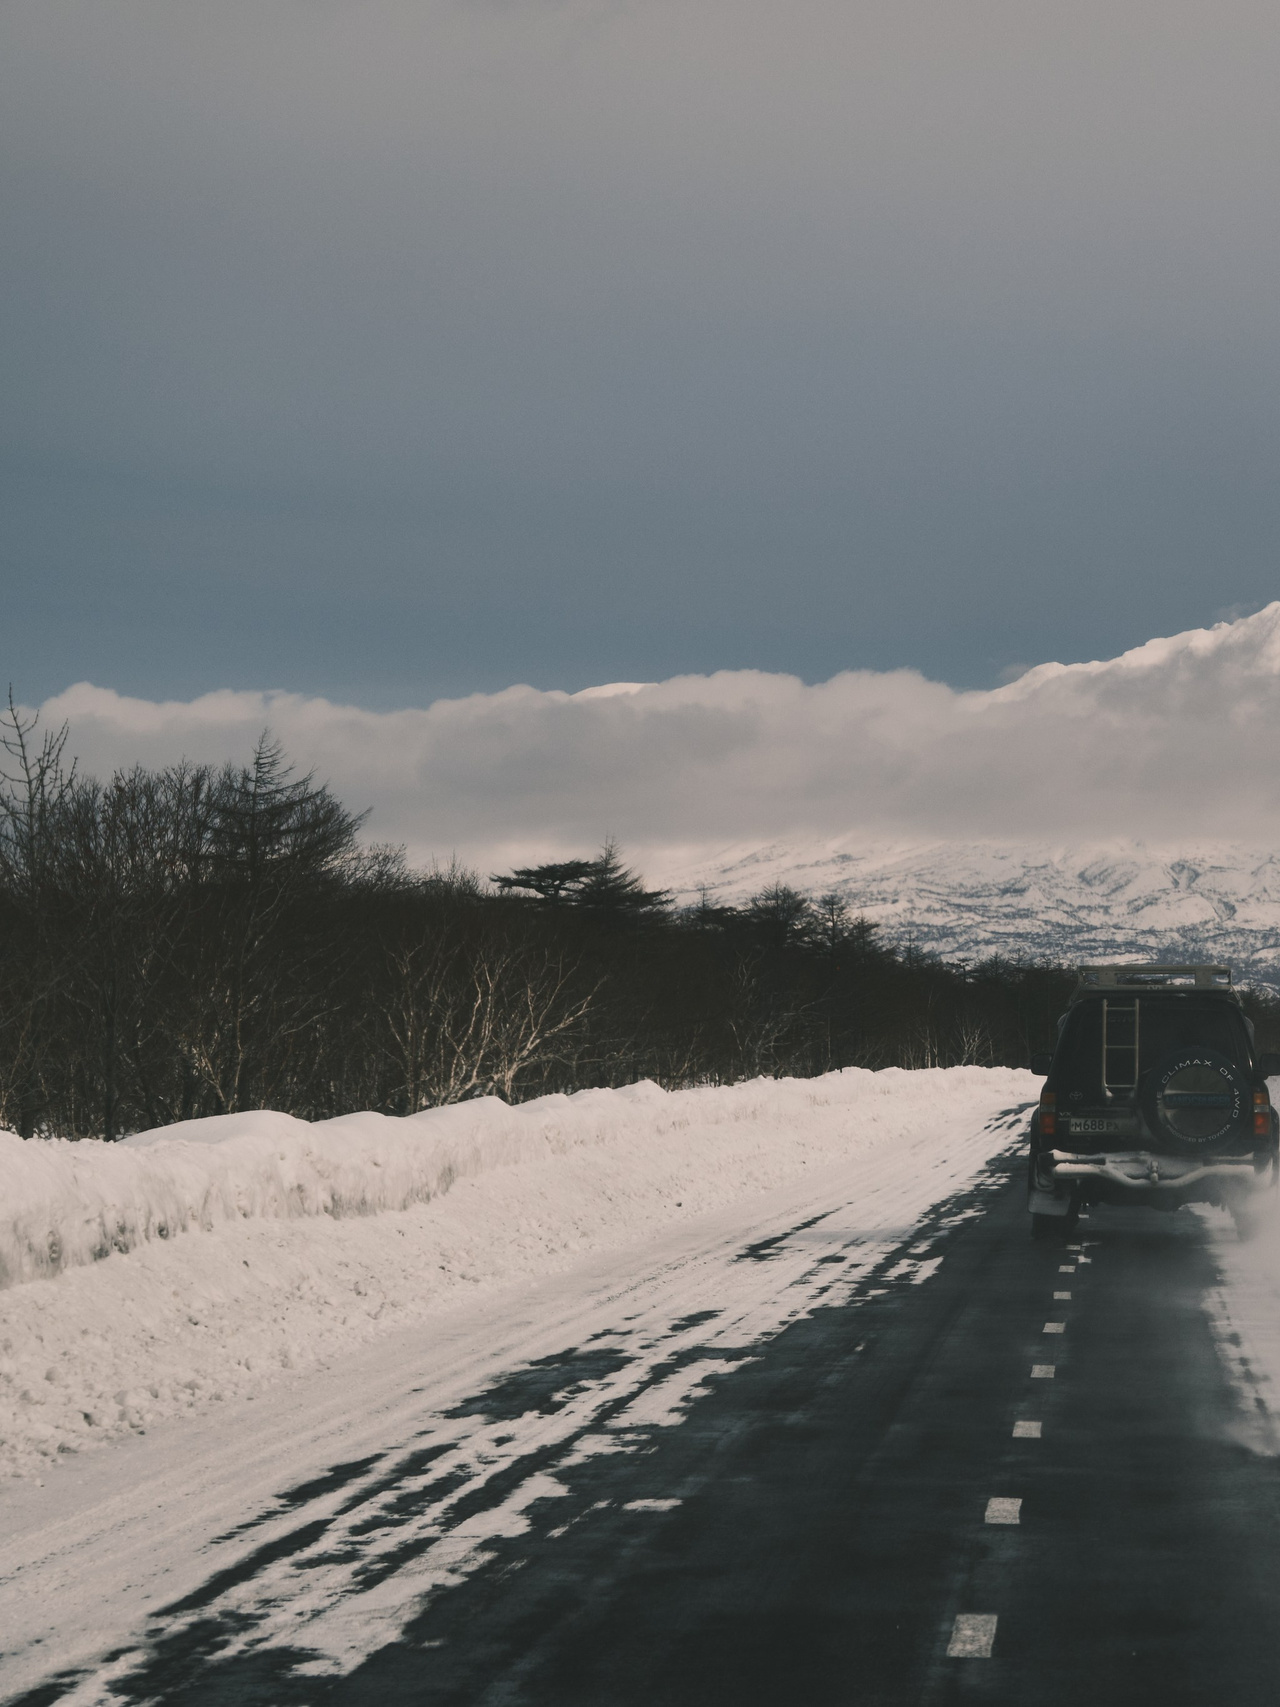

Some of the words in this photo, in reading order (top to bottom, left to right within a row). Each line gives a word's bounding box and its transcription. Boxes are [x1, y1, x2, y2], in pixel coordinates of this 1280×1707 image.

[1161, 1059, 1212, 1084] CLIMAX
[1219, 1067, 1234, 1081] OF
[1232, 1088, 1240, 1118] 4WD
[1208, 1124, 1231, 1141] TOYOTA
